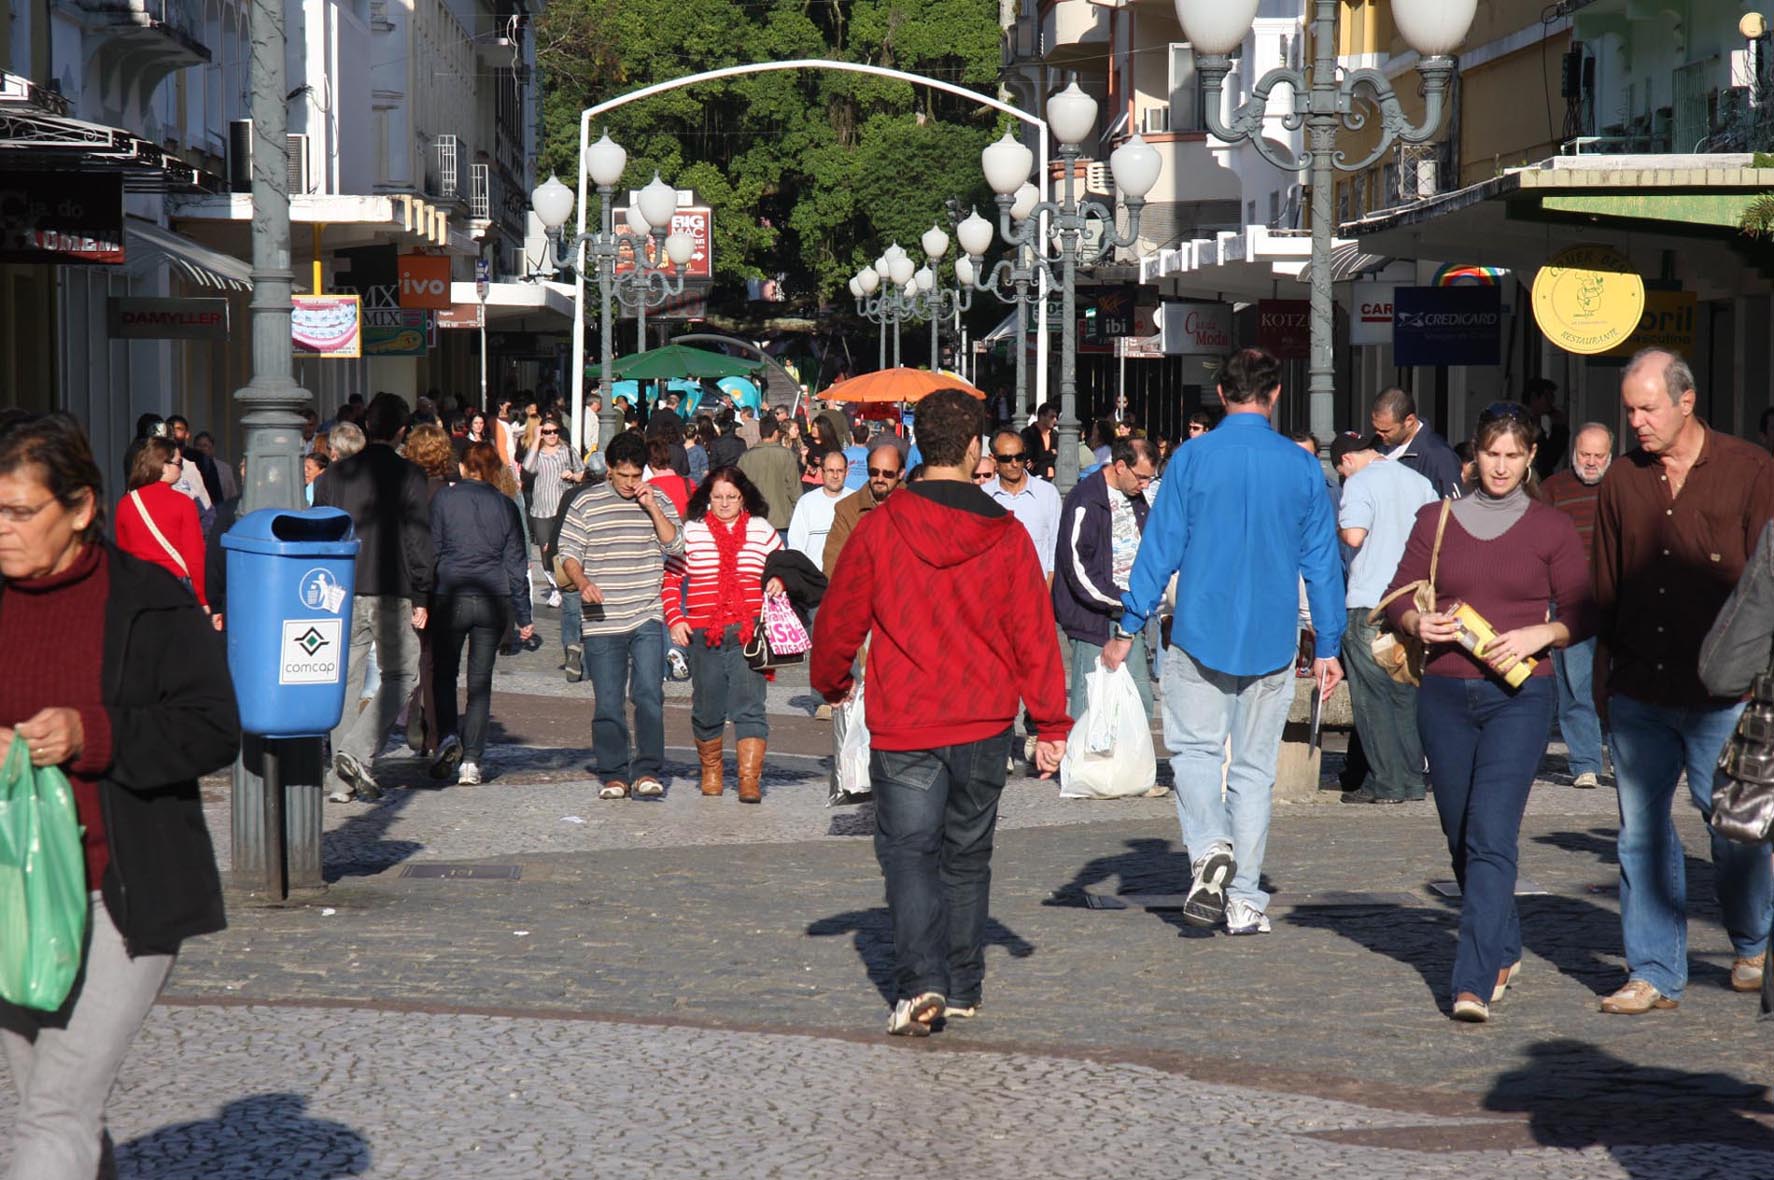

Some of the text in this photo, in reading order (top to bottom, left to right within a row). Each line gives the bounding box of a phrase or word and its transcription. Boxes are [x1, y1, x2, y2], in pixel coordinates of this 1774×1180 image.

[672, 215, 704, 228] BIG
[398, 271, 446, 296] ivo
[122, 311, 222, 325] DAMYLLER
[1424, 312, 1497, 327] CREDICARD
[1105, 318, 1127, 334] ibi
[1560, 328, 1618, 345] RESTAURANTE
[286, 663, 335, 675] comcap
